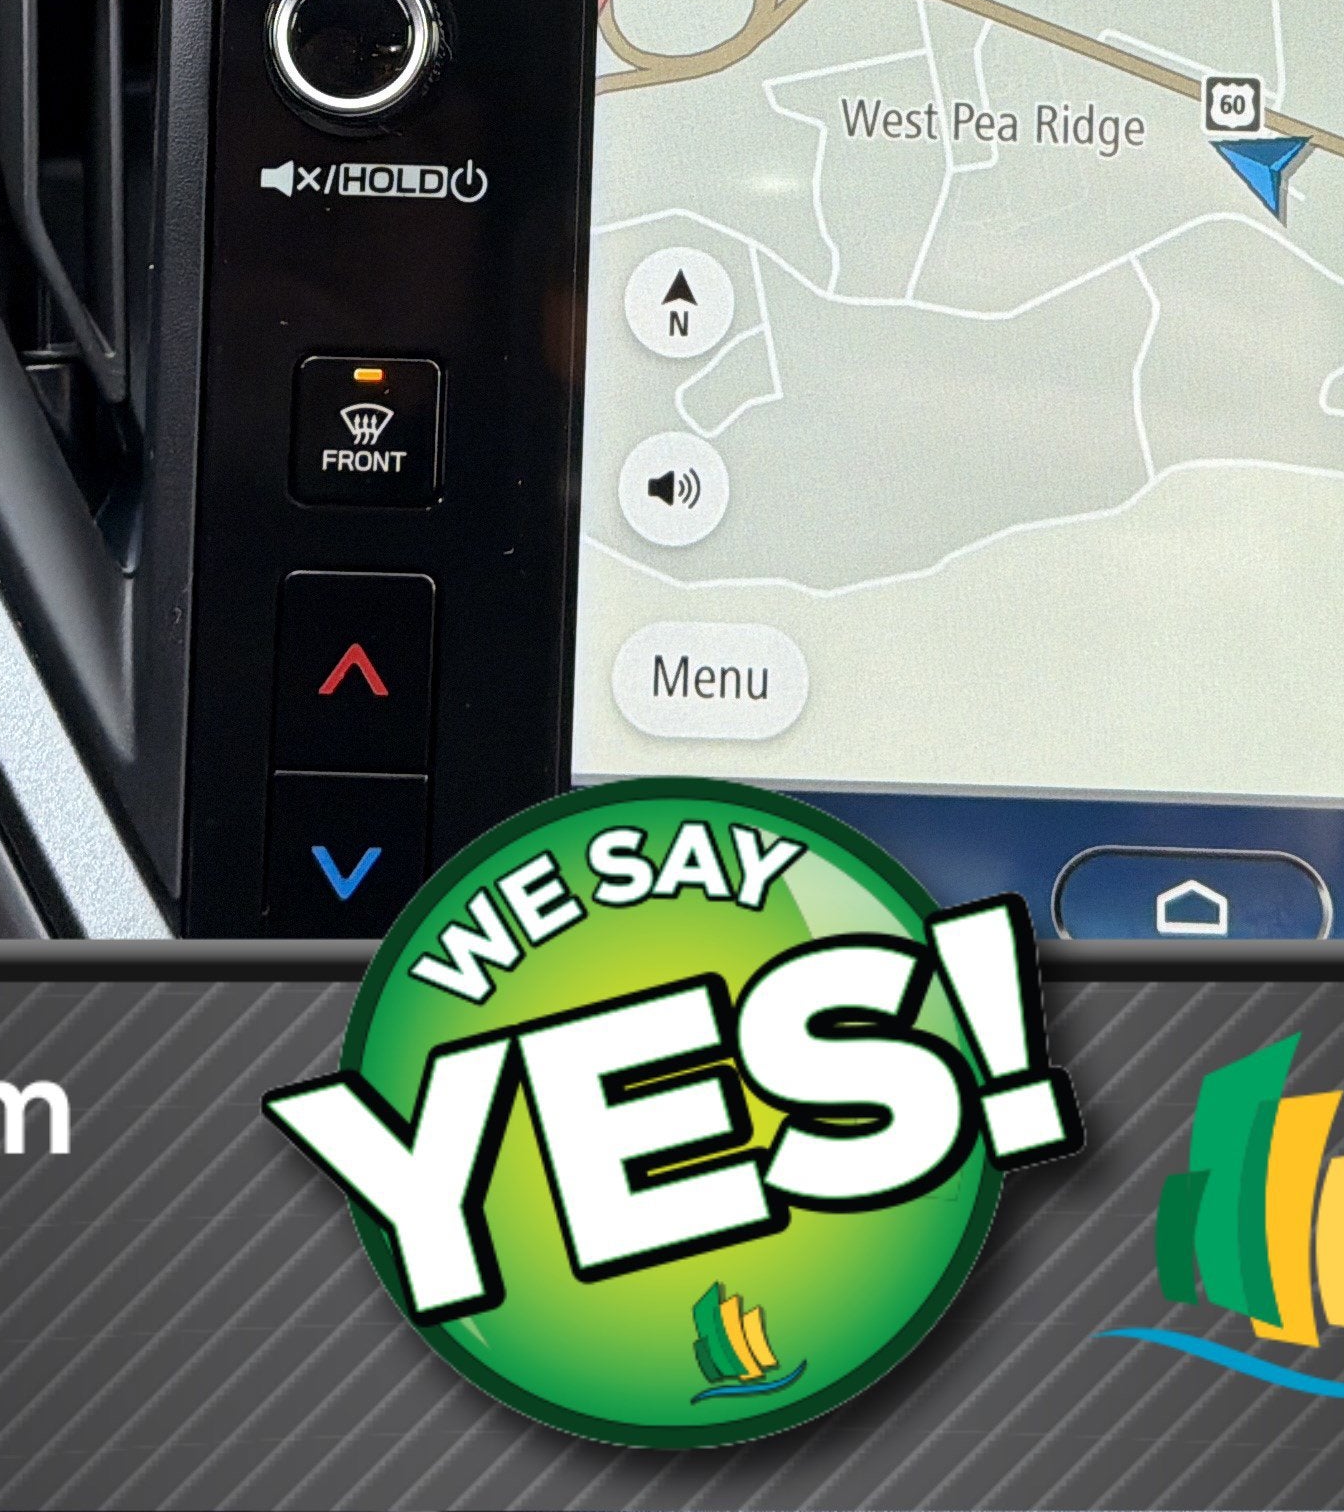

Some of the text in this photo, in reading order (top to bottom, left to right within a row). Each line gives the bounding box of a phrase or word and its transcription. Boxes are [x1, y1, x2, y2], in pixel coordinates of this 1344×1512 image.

[1220, 94, 1246, 115] 60
[842, 98, 1146, 156] West Pea Ridge
[669, 311, 689, 336] N
[322, 450, 407, 473] FRONT
[653, 654, 769, 700] Menu
